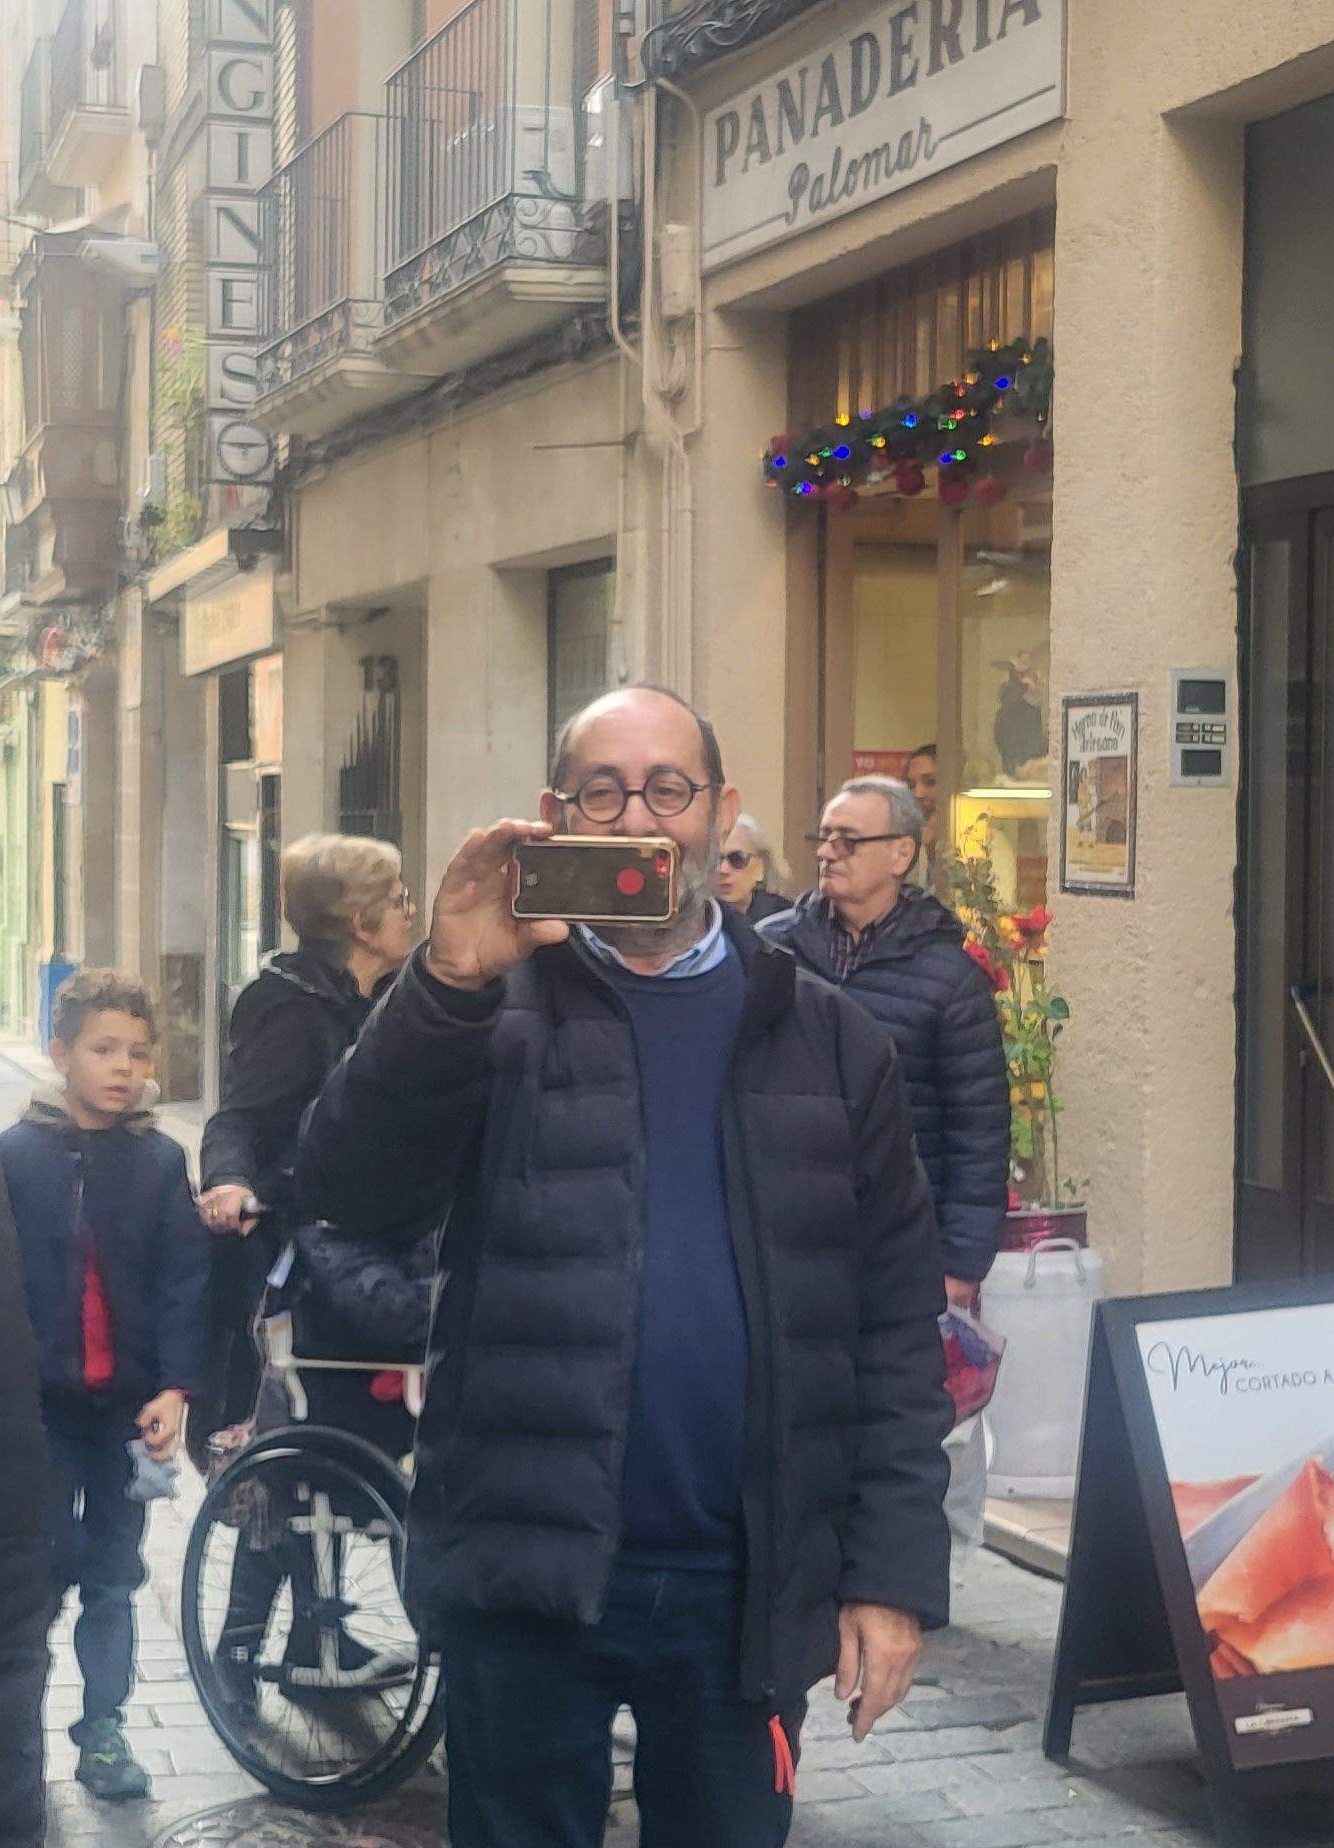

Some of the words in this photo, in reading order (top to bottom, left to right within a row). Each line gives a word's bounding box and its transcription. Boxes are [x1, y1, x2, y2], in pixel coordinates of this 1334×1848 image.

[784, 116, 939, 226] Palomar
[1235, 1371, 1317, 1393] CORTADO
[1323, 1371, 1334, 1384] A
